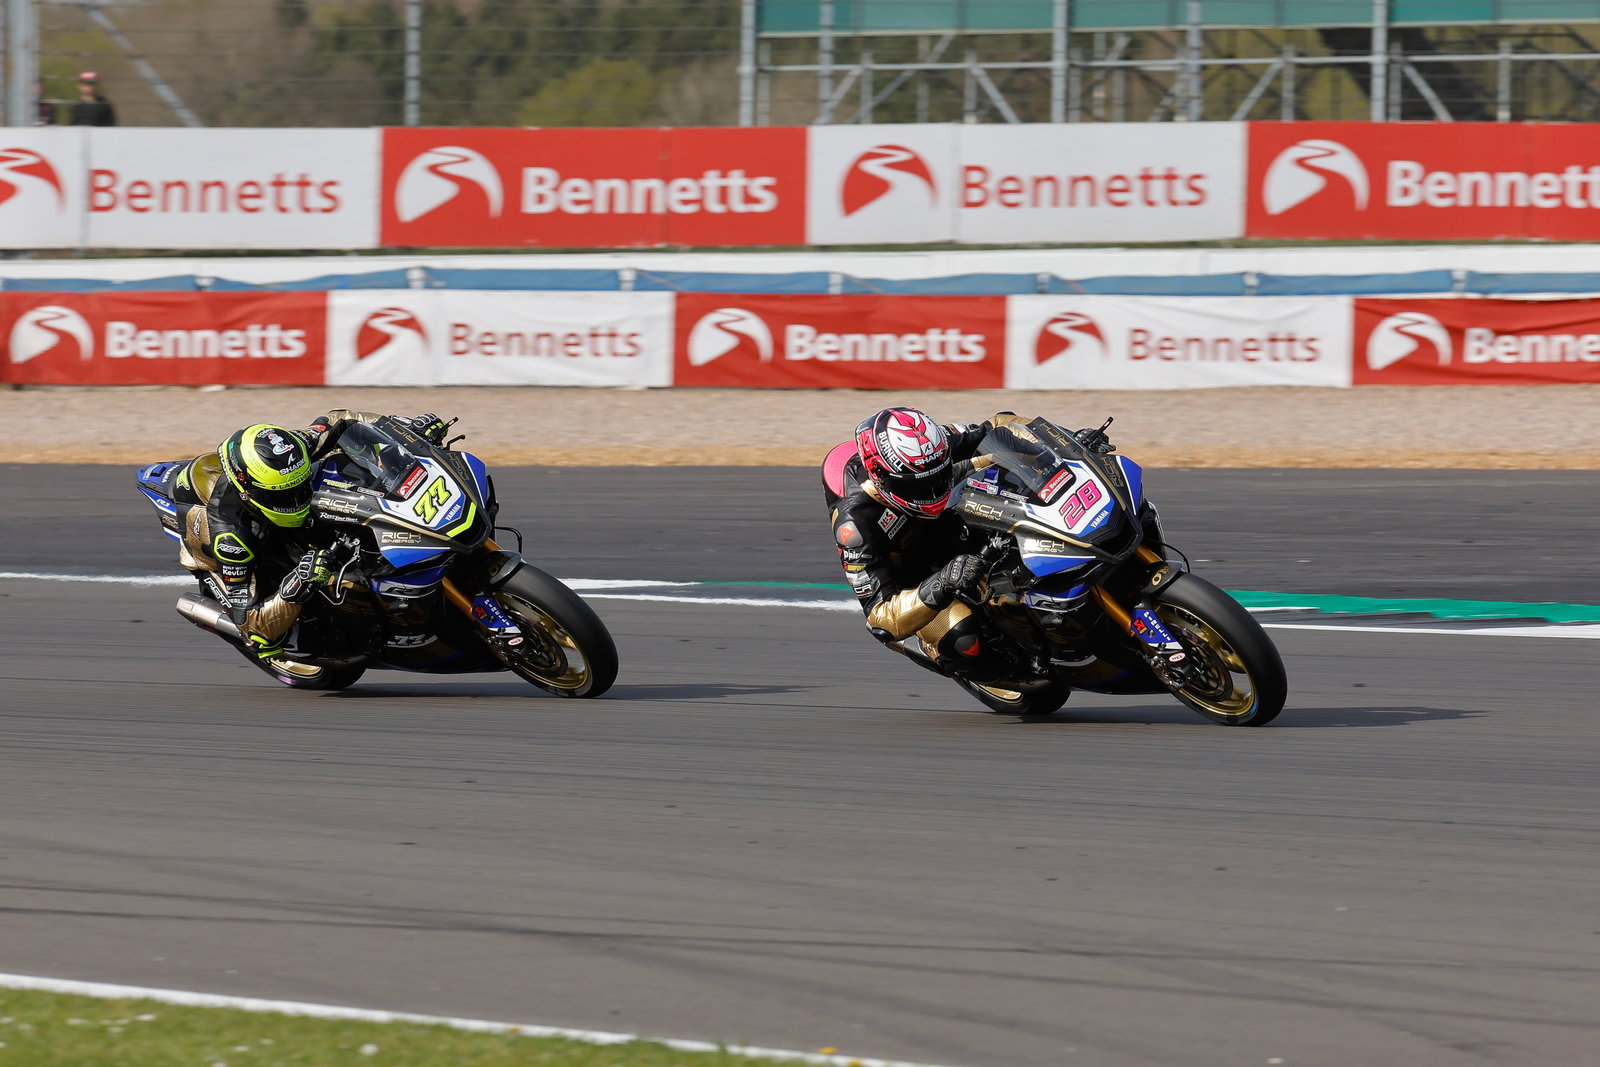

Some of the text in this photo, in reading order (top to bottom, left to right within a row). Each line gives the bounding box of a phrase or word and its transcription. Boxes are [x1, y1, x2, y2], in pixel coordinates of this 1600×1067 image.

[88, 168, 342, 213] Bennetts
[521, 166, 779, 214] Bennetts
[961, 164, 1209, 208] Bennetts
[105, 321, 307, 358] Bennetts
[450, 322, 643, 357] Bennetts
[784, 324, 986, 362] Bennetts
[1129, 328, 1321, 362] Bennetts
[1463, 327, 1600, 363] Benne
[280, 459, 305, 475] SHARK
[878, 431, 903, 472] BURNELL
[914, 449, 944, 466] SHARK
[318, 497, 358, 511] RICH
[412, 475, 452, 525] 77
[964, 500, 1004, 517] RICH
[1058, 478, 1103, 530] 28
[381, 532, 422, 540] RICH
[1090, 510, 1110, 529] YAMAHA
[217, 543, 247, 555] RST
[204, 577, 233, 609] RST
[484, 599, 510, 626] PIRELLI
[1143, 611, 1171, 641] PIRELLI
